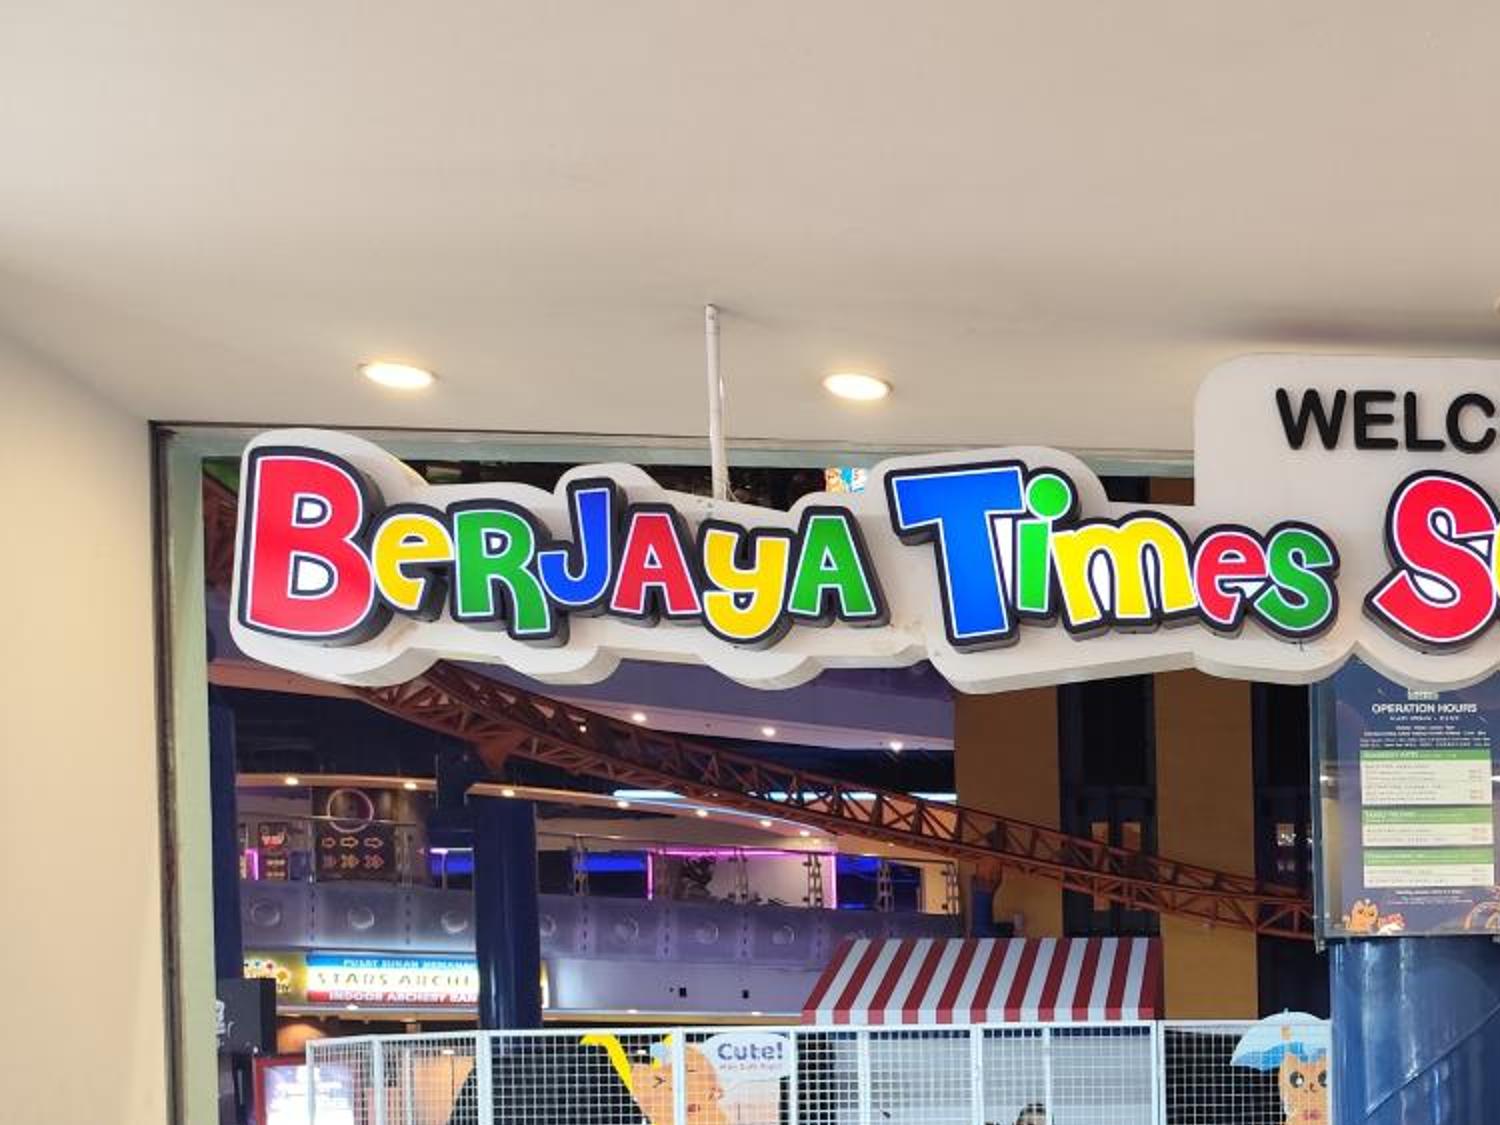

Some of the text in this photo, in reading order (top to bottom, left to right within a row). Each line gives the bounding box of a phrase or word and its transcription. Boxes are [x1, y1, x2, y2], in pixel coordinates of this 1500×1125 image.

[1371, 703, 1478, 713] OPERATION HOURS
[717, 1041, 784, 1060] Cute!
